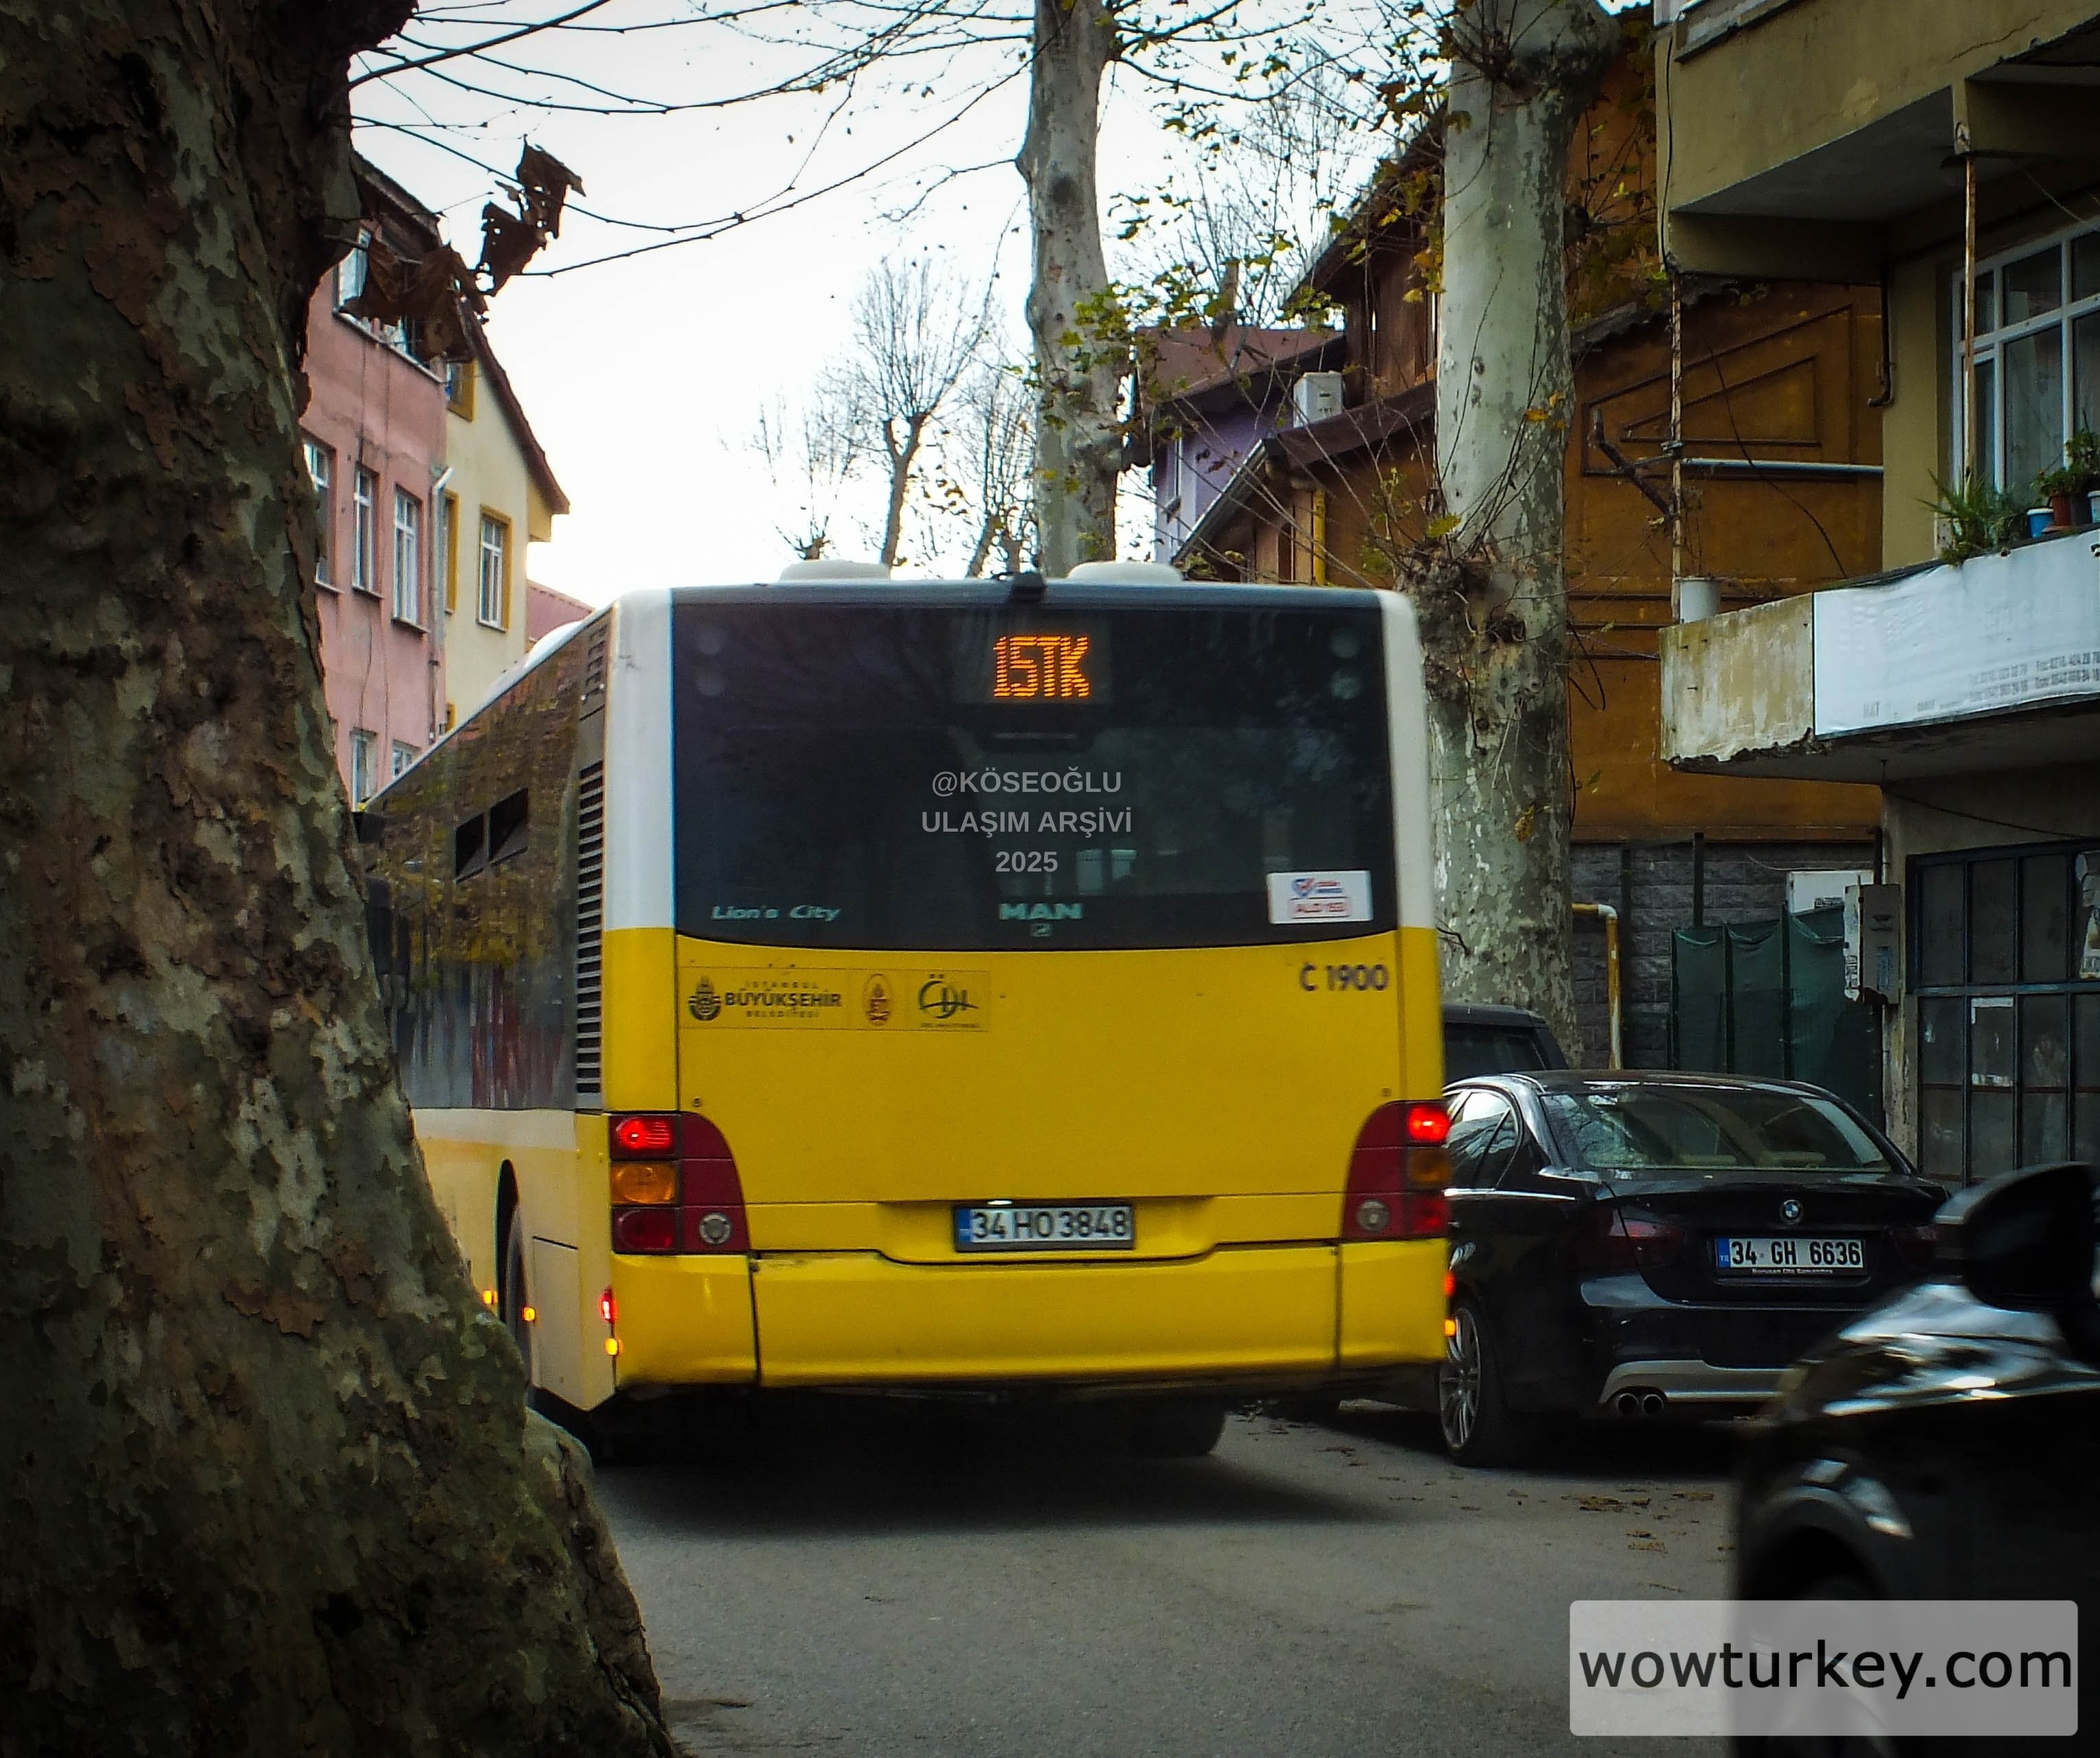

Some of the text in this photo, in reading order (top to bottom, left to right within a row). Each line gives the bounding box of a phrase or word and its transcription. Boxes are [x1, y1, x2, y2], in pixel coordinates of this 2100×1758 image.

[993, 635, 1090, 698] 15TK
[711, 904, 842, 923] Lion's City
[998, 902, 1085, 921] MAN
[1325, 963, 1389, 992] 1900
[724, 988, 842, 1011] BÜYÜKŞEHİR
[1731, 1241, 1758, 1265] 34
[1770, 1241, 1797, 1265] GH
[1808, 1241, 1862, 1265] 6636
